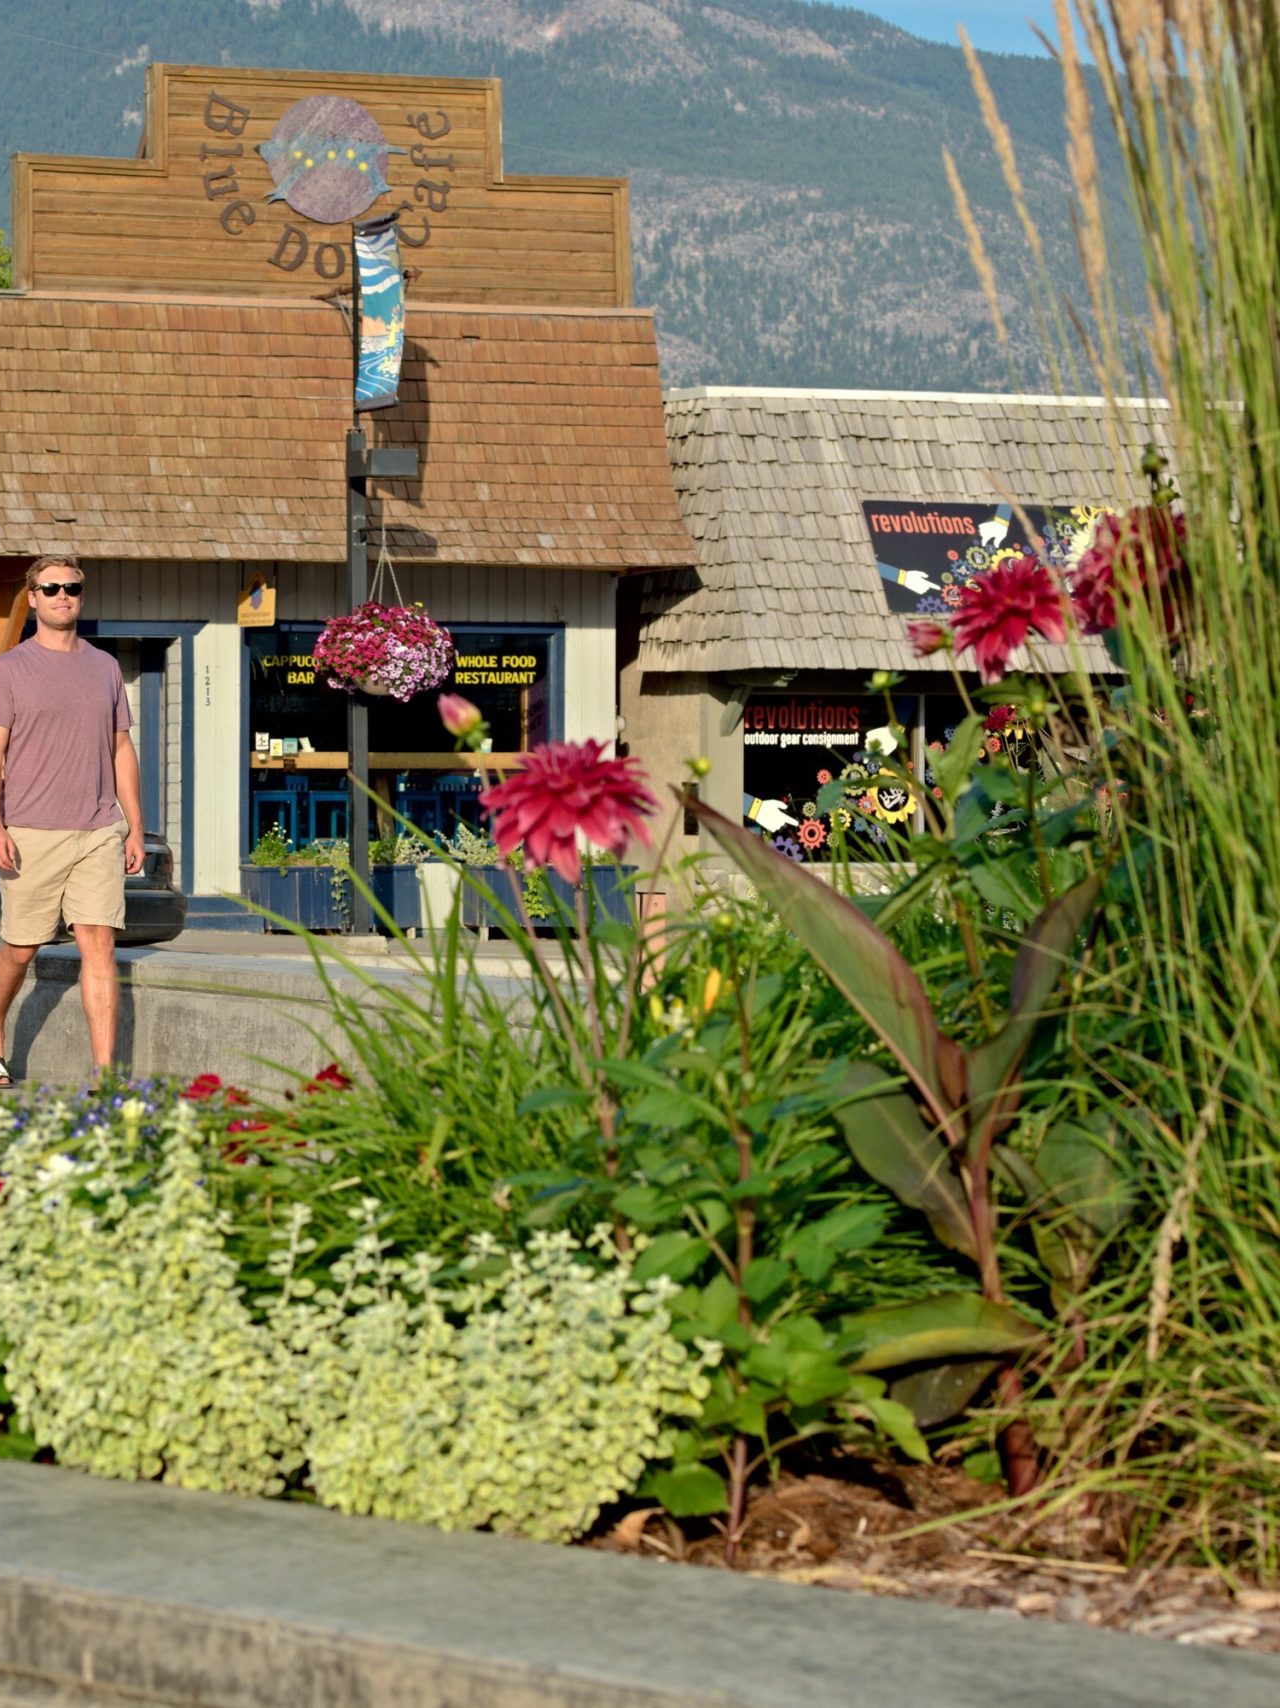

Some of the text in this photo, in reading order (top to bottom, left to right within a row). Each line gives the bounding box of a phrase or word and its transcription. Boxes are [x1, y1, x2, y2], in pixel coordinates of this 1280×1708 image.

[200, 91, 456, 279] Blue Do Café
[871, 510, 976, 534] revolutions
[455, 655, 498, 668] WHOLE
[502, 655, 537, 668] FOOD
[287, 671, 537, 684] BAR RESTAURANT
[744, 699, 860, 729] revolutions
[744, 731, 859, 748] outdoor gear consignment
